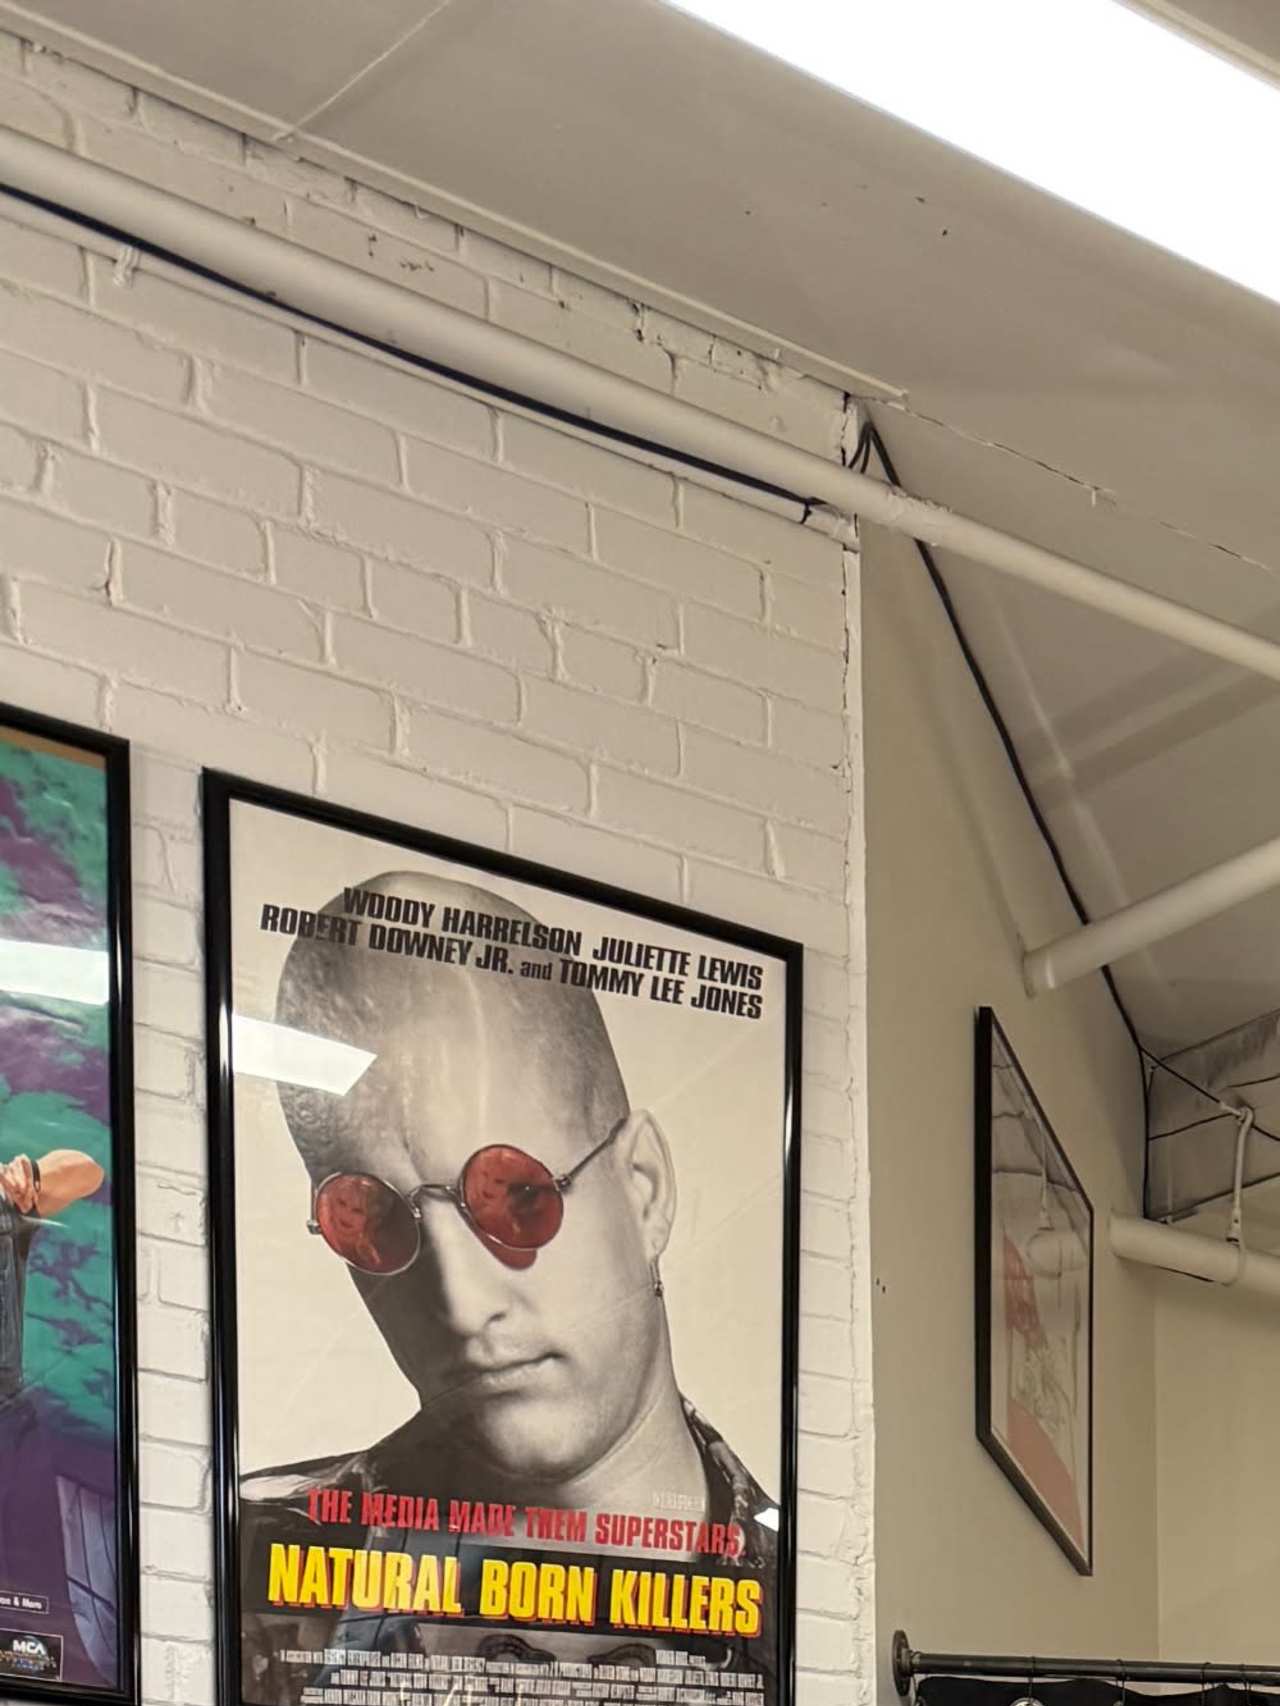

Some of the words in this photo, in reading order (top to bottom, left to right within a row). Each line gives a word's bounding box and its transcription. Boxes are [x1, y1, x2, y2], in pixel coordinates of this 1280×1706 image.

[260, 904, 360, 946] ROBERT
[369, 924, 474, 967] DOWNEY
[475, 949, 515, 975] JR.
[520, 959, 553, 981] and
[558, 958, 643, 997] TOMMY
[649, 977, 684, 1005] LEE
[690, 984, 763, 1020] JONES
[343, 887, 436, 929] WOODY
[441, 906, 583, 956] HARRELSON
[591, 936, 693, 976] JULIETTE
[698, 955, 763, 991] LEWIS
[307, 1487, 352, 1526] THE
[361, 1492, 440, 1532] MEDIA
[448, 1499, 515, 1538] MADE
[525, 1506, 586, 1544] THEM
[267, 1542, 465, 1618] NATURAL
[479, 1559, 597, 1627] BORN
[608, 1569, 763, 1638] KILLERS
[13, 1639, 46, 1655] MCA
